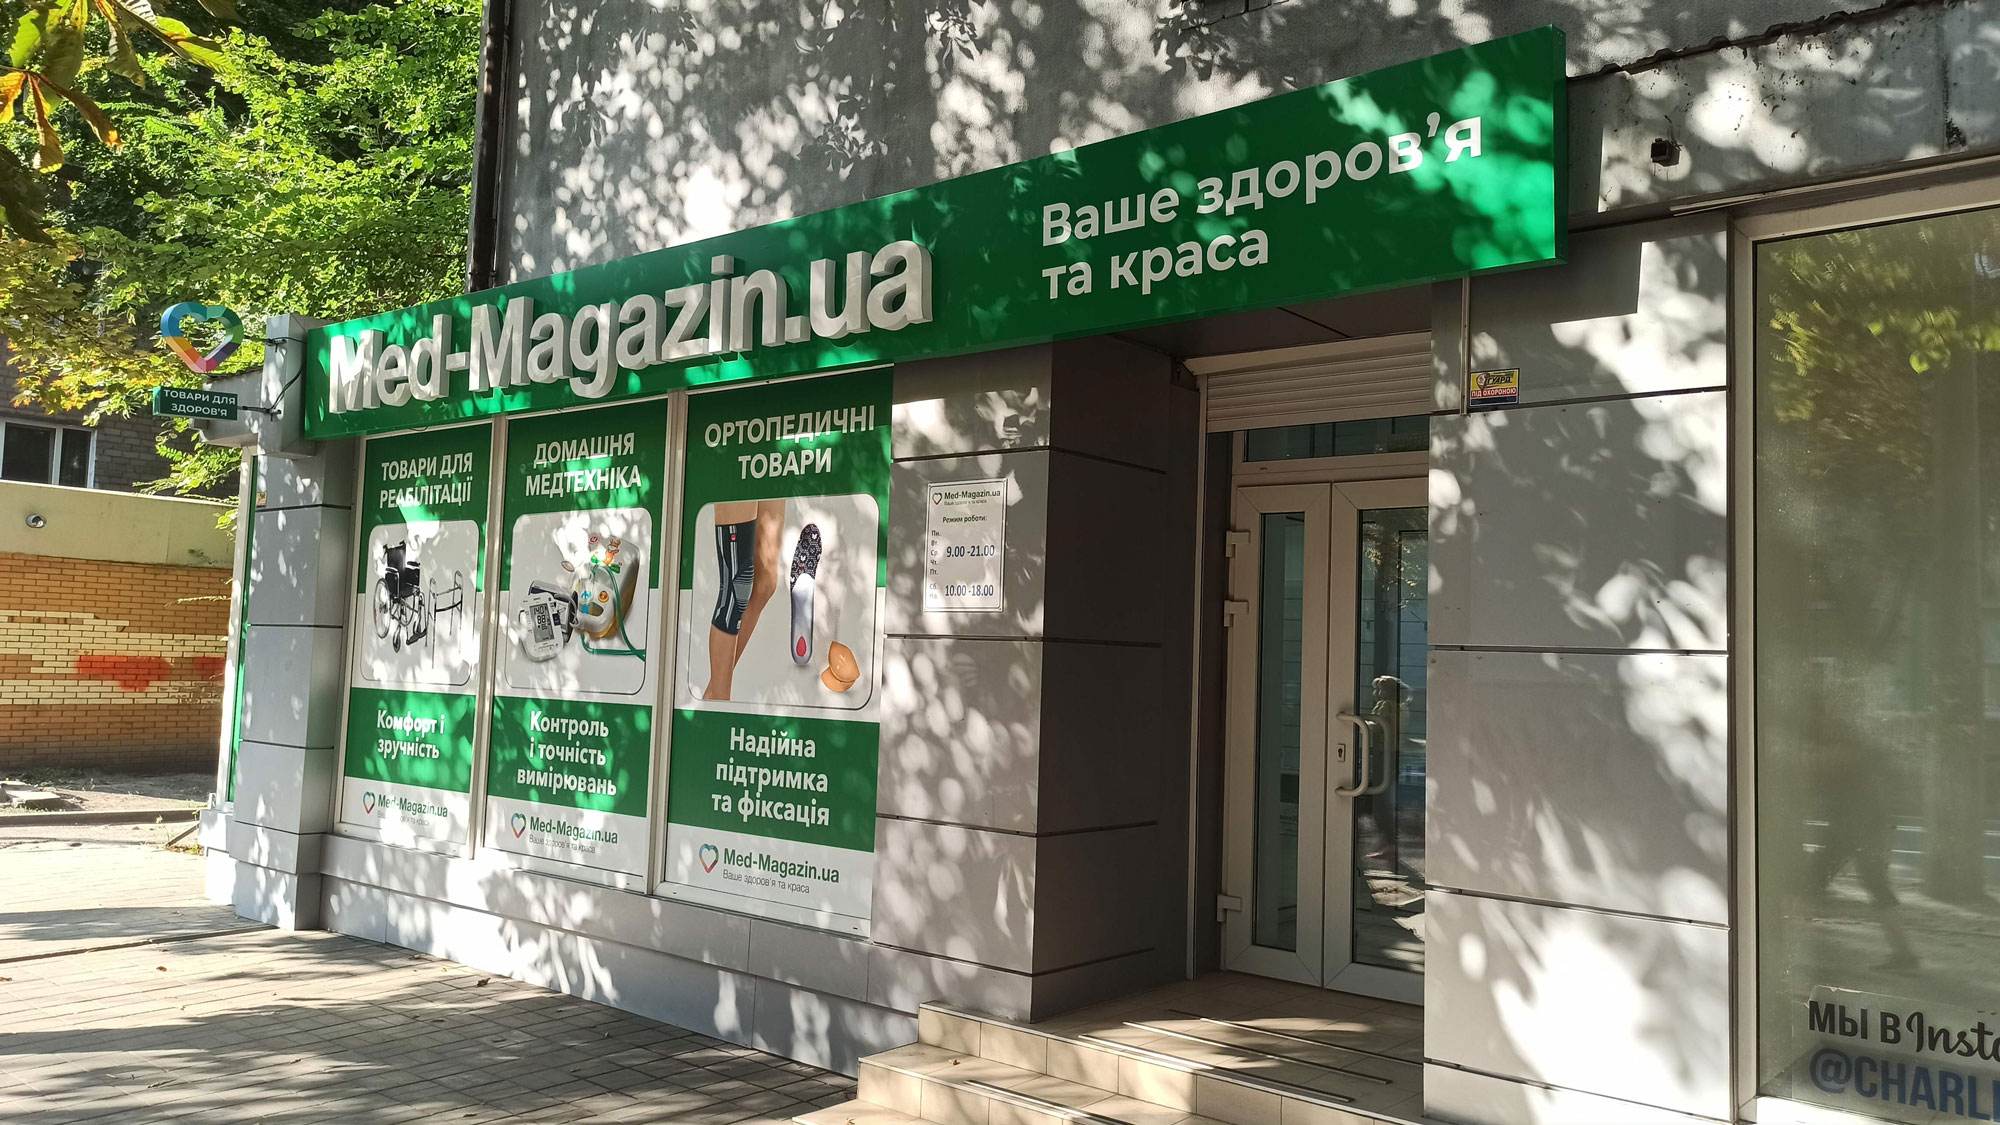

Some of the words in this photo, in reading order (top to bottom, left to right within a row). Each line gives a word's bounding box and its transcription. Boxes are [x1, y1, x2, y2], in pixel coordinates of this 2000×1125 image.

[1041, 187, 1180, 247] Ваше
[1196, 111, 1483, 216] здоров'я
[1041, 261, 1092, 301] та
[1109, 229, 1269, 295] краса
[328, 239, 934, 415] Med-Magazin.ua
[163, 389, 210, 402] ТОВАРИ
[212, 395, 236, 405] ДЛЯ
[1482, 388, 1517, 396] ОХОРОНОЮ
[171, 403, 228, 417] ЗДОРОВ'Я
[704, 404, 875, 448] ОРТОПЕДИЧНІ
[533, 432, 635, 469] ДОМАШНЯ
[738, 447, 832, 480] ТОВАРИ
[381, 456, 437, 482] ТОВАРИ
[439, 452, 473, 479] ДЛЯ
[525, 464, 642, 499] МЕДТЕХНІКА
[379, 476, 473, 509] РЕАБІЛІТАЦІЇ
[944, 489, 1001, 500] Med-Magazin.ua
[942, 516, 963, 524] Режим
[964, 514, 988, 524] роботи:
[946, 546, 965, 558] 9.00
[945, 585, 966, 597] 10.00
[376, 709, 438, 738] Комфорт
[440, 714, 445, 734] і
[530, 710, 610, 740] Контроль
[377, 737, 440, 760] зручність
[529, 736, 535, 758] і
[538, 740, 607, 766] точність
[729, 726, 816, 758] Надійна
[516, 766, 617, 796] вимірювань
[715, 757, 829, 793] підтримка
[711, 793, 733, 813] та
[737, 789, 830, 828] фіксація
[529, 834, 544, 845] Ваше
[530, 816, 618, 844] Med-Magazin.ua
[722, 868, 743, 882] Ваше
[743, 874, 776, 888] здоров'я
[778, 880, 786, 890] та
[787, 882, 810, 894] краса
[723, 848, 840, 884] Med-Magazin.ua
[1808, 1000, 1868, 1040] МЫ
[1880, 1011, 1902, 1045] В
